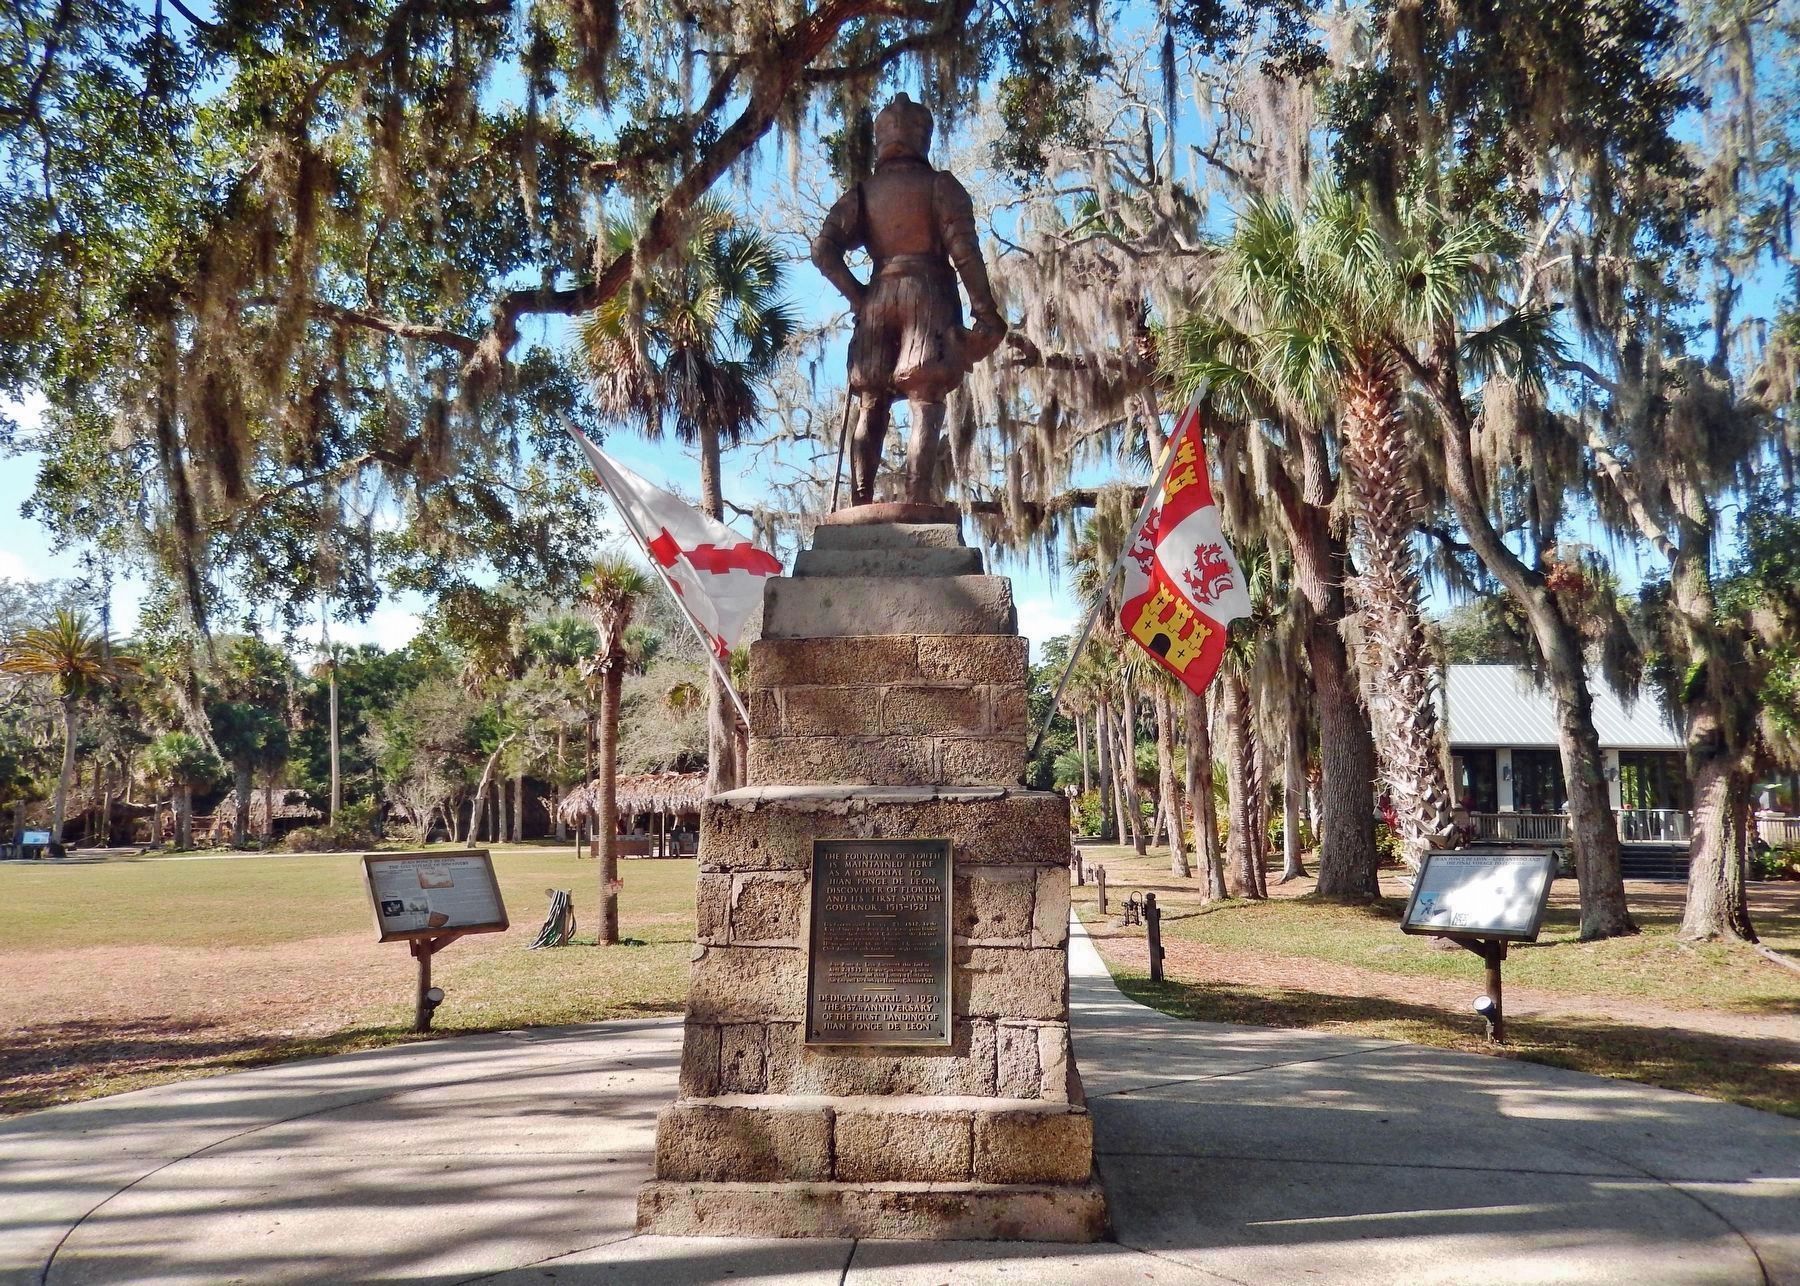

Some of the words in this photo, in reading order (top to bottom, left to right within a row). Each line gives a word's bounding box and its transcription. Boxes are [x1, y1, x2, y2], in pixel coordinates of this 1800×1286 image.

[818, 994, 872, 1002] DEDICATED
[874, 994, 902, 1002] APRIL
[916, 994, 940, 1002] 1950
[864, 1004, 934, 1012] ANNIVERSARY
